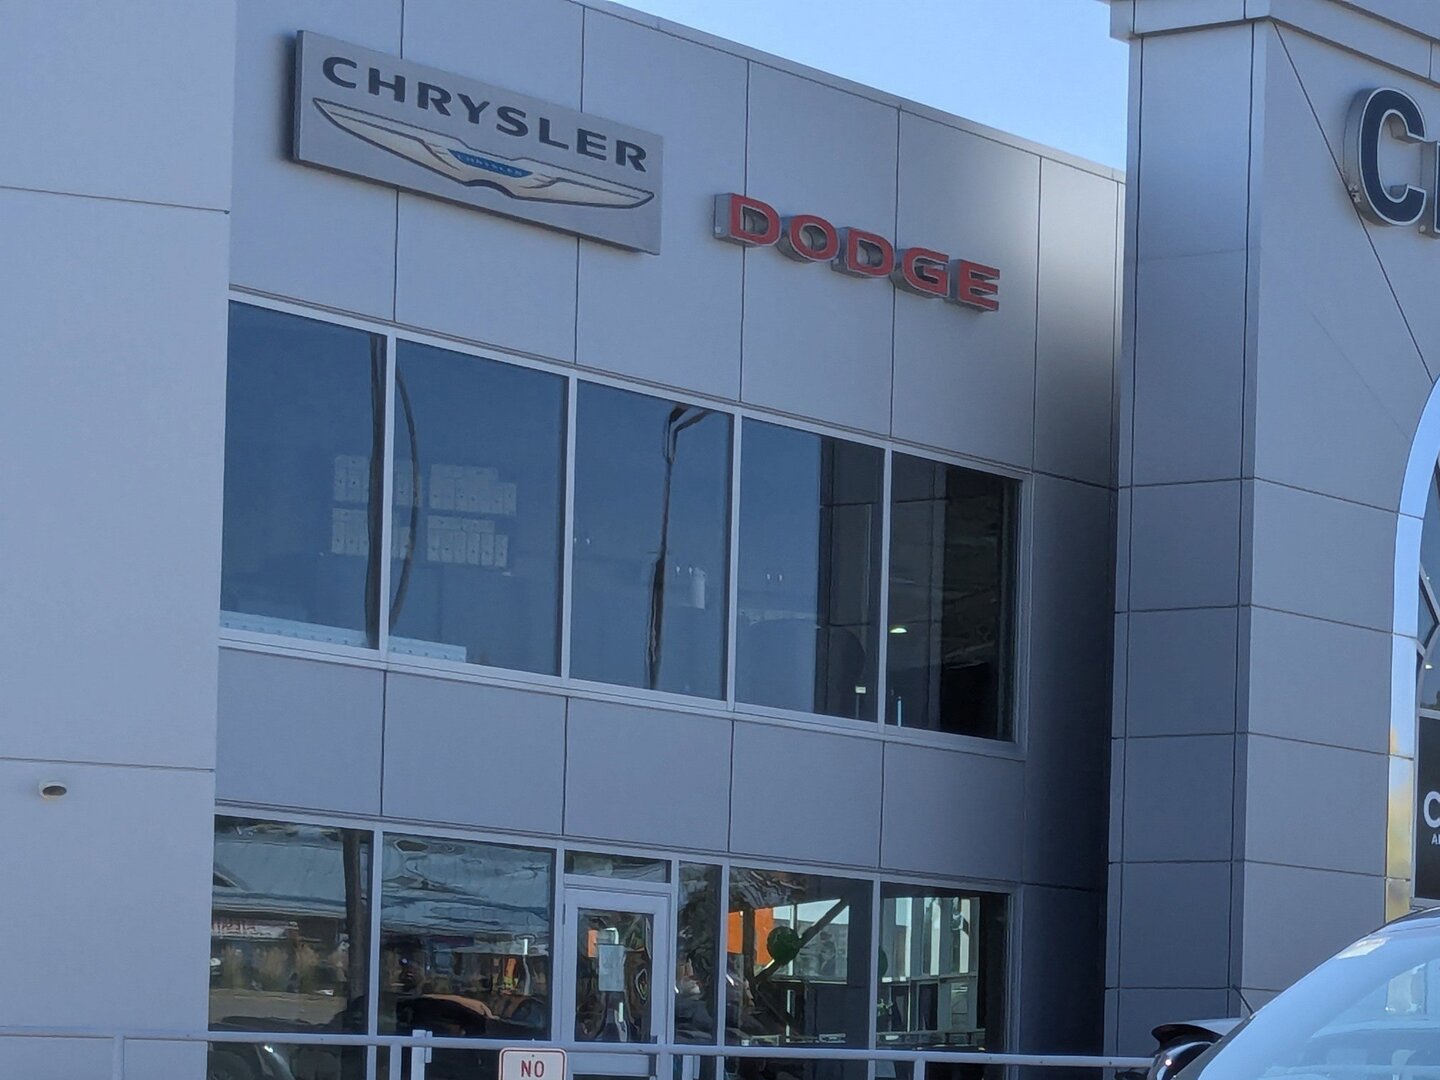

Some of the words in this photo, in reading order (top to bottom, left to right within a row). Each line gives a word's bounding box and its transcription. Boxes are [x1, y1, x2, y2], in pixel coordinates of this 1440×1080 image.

[321, 56, 649, 173] CHRYSLER
[724, 193, 1001, 312] DODGE
[521, 1060, 545, 1078] NO
